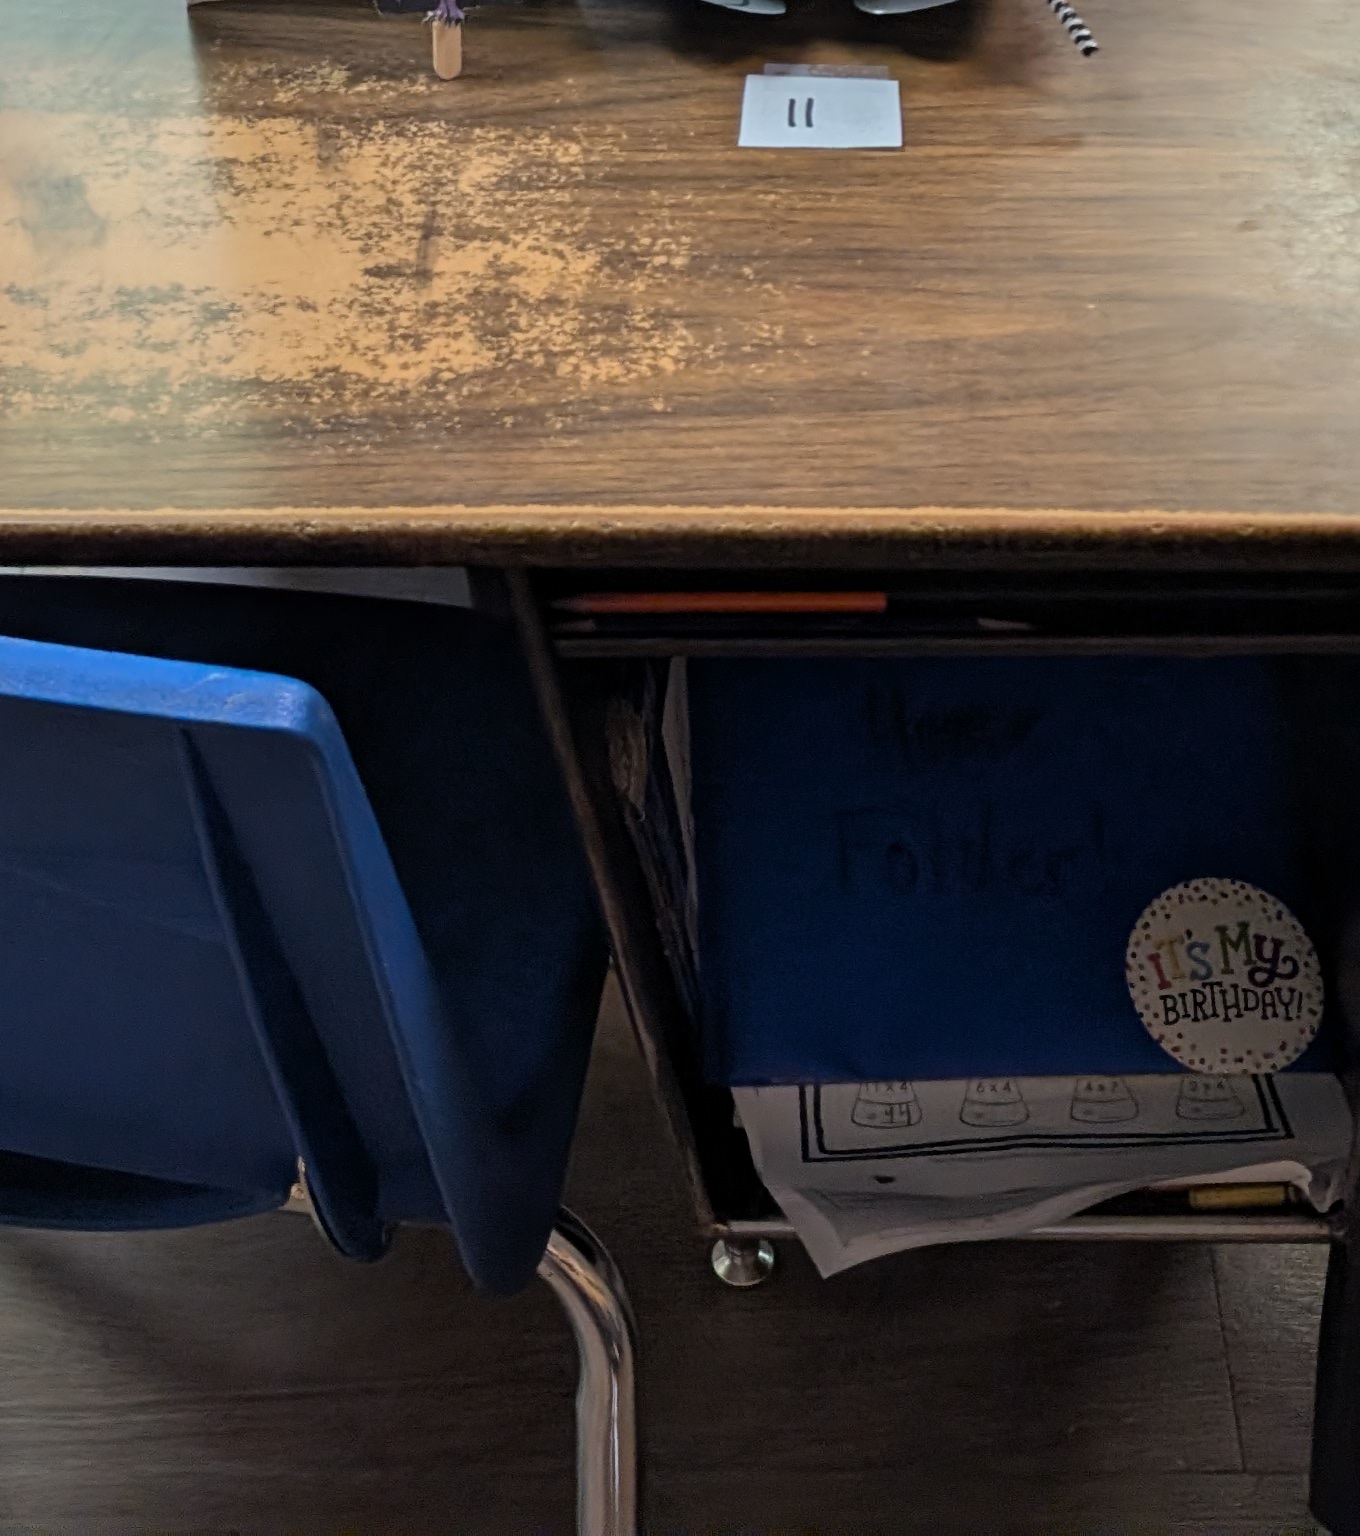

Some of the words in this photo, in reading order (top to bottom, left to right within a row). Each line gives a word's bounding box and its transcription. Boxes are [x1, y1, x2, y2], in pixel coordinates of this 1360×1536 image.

[787, 97, 815, 128] 11
[1147, 928, 1214, 990] IT'S
[1158, 980, 1303, 1026] BIRTHDAY!
